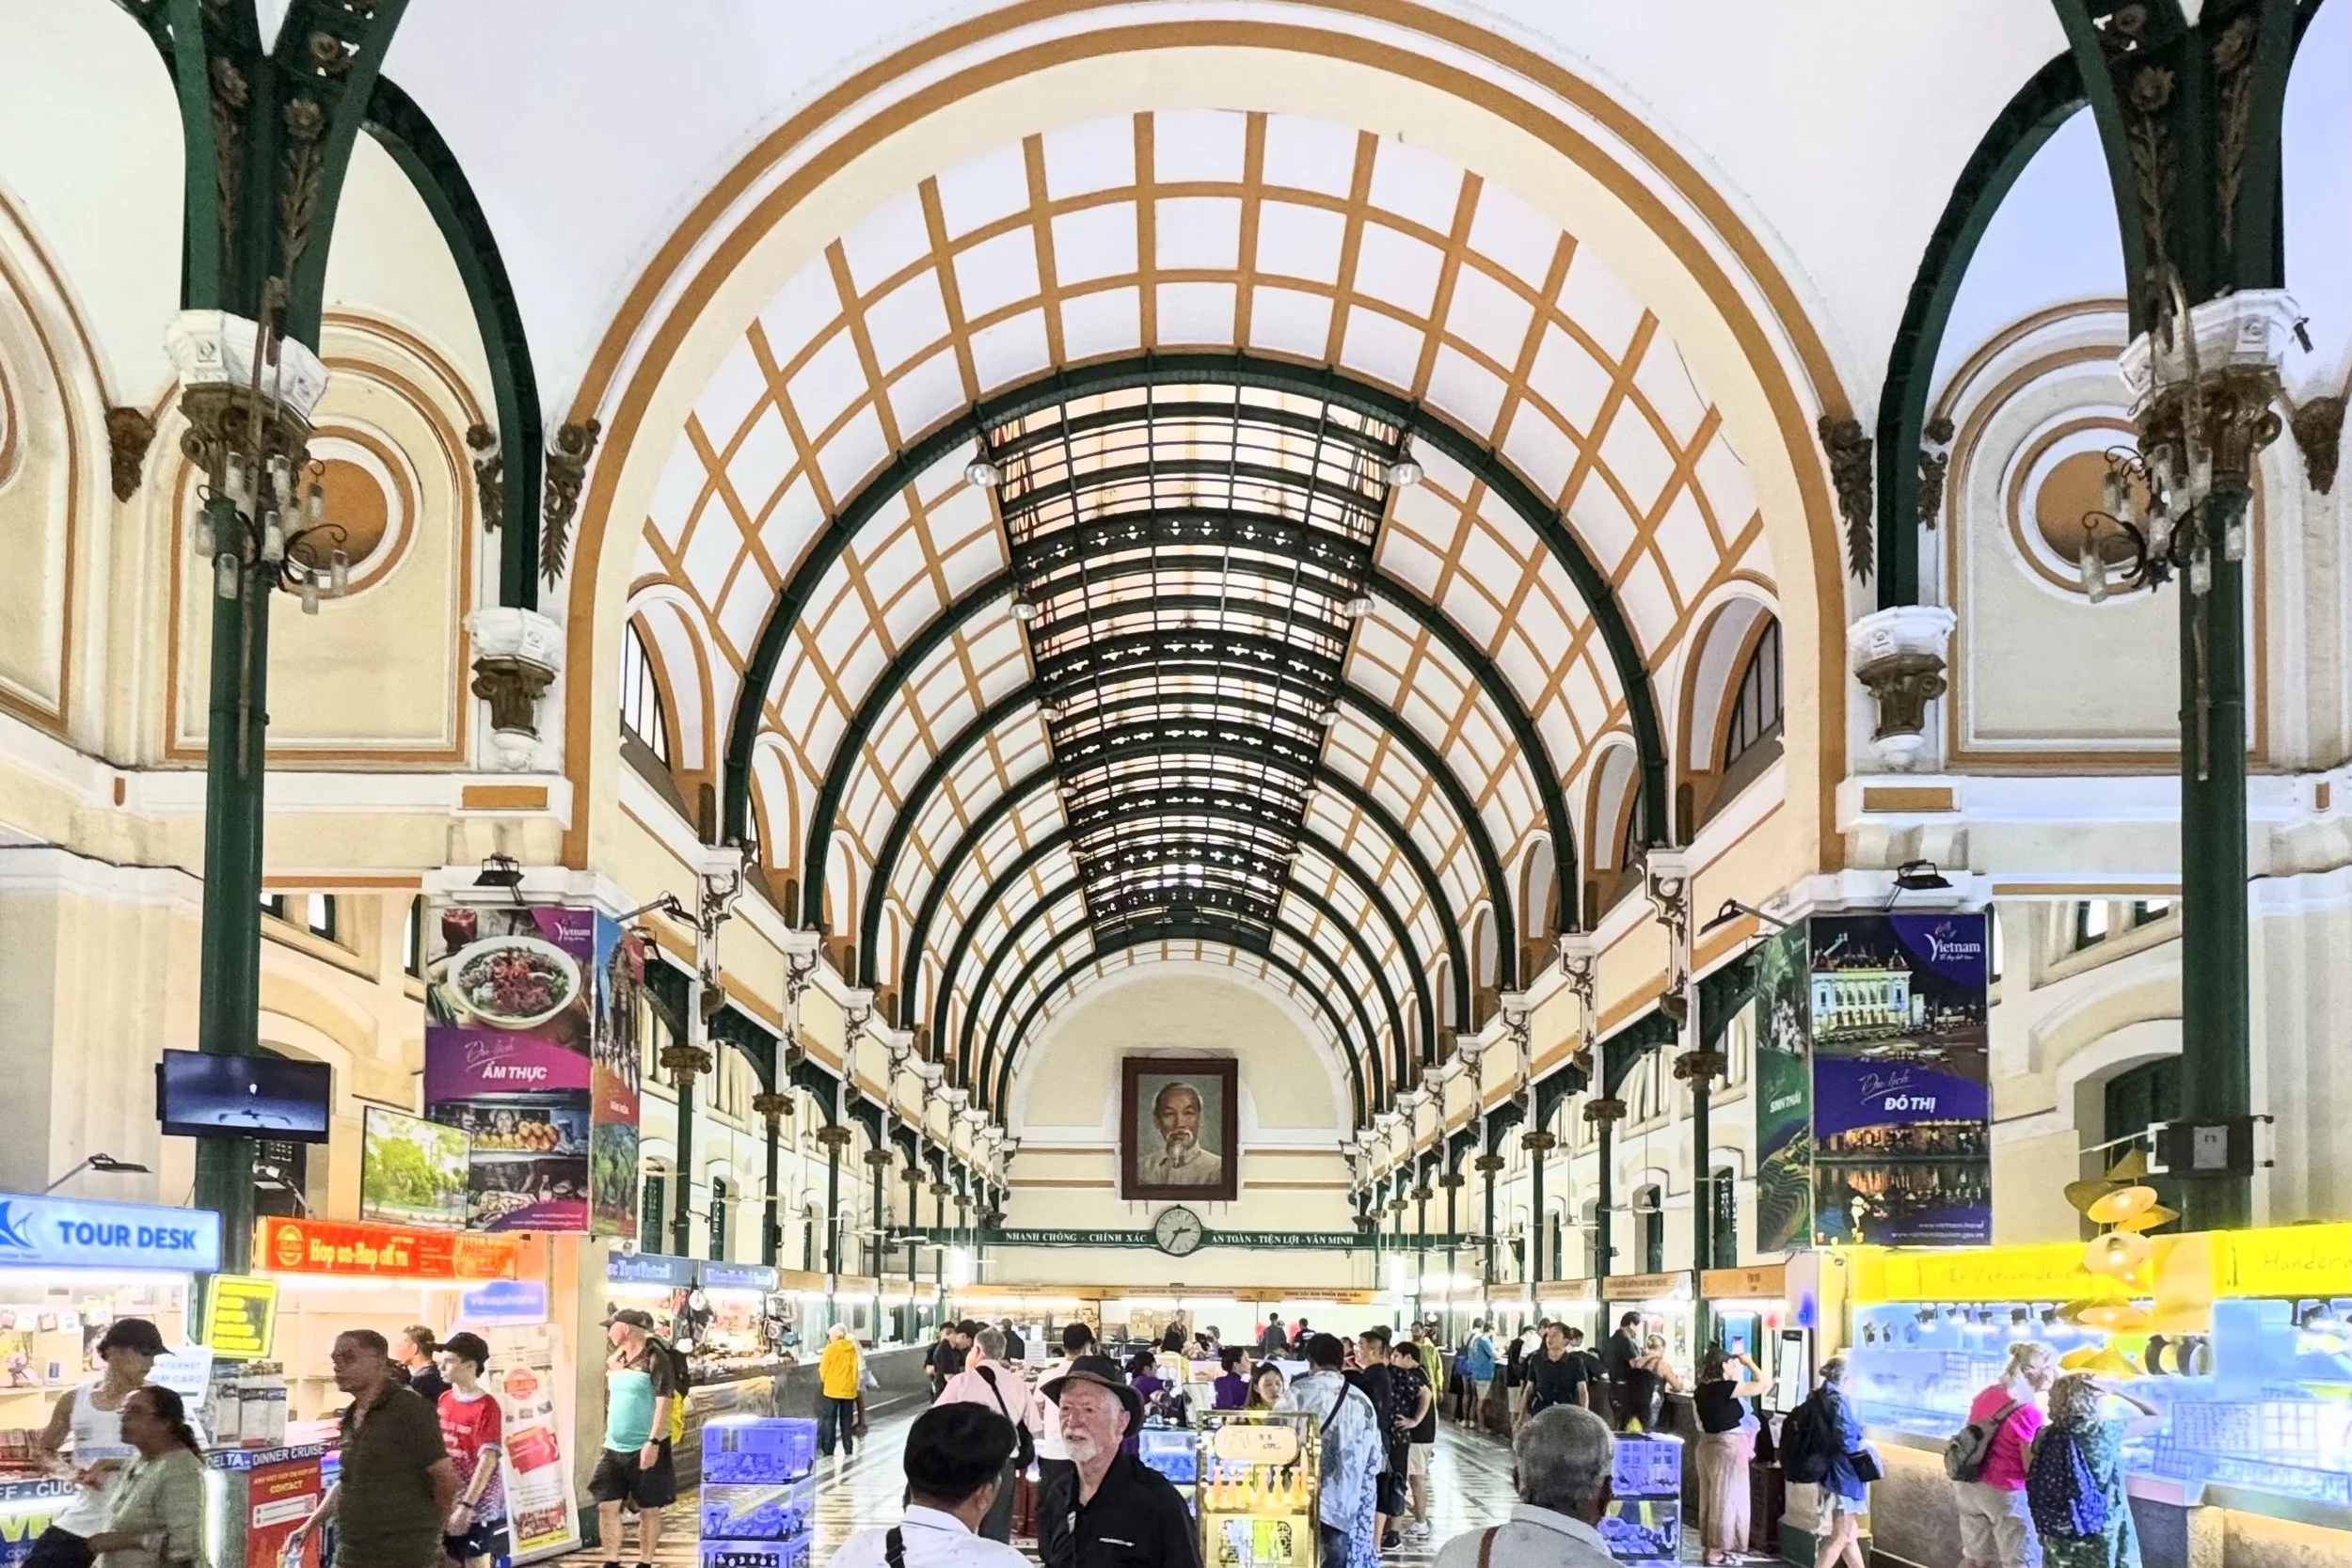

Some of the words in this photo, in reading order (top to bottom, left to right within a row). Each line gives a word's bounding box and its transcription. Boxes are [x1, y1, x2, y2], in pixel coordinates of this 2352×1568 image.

[1924, 933, 1980, 962] Vietnam
[508, 1065, 548, 1083] THỰC
[1910, 1097, 1937, 1114] THỊ
[58, 1221, 132, 1247] TOUR
[137, 1227, 199, 1250] DESK
[1006, 1231, 1040, 1242] NHANH
[1041, 1229, 1077, 1243] CHÓNG
[1089, 1230, 1122, 1243] CHÍNH
[1125, 1231, 1148, 1243] XÁC
[1211, 1234, 1225, 1244] AN
[1226, 1232, 1253, 1244] TOÀN
[1258, 1234, 1282, 1245] TIỆN
[1283, 1235, 1299, 1246] LỢI
[1306, 1233, 1326, 1245] VĂN
[1327, 1235, 1355, 1245] MINH
[310, 1237, 335, 1269] Hop
[337, 1241, 377, 1272] on-Hop
[252, 1449, 290, 1466] DINNER
[290, 1444, 326, 1459] CRUISE
[269, 1480, 304, 1495] CONTACT
